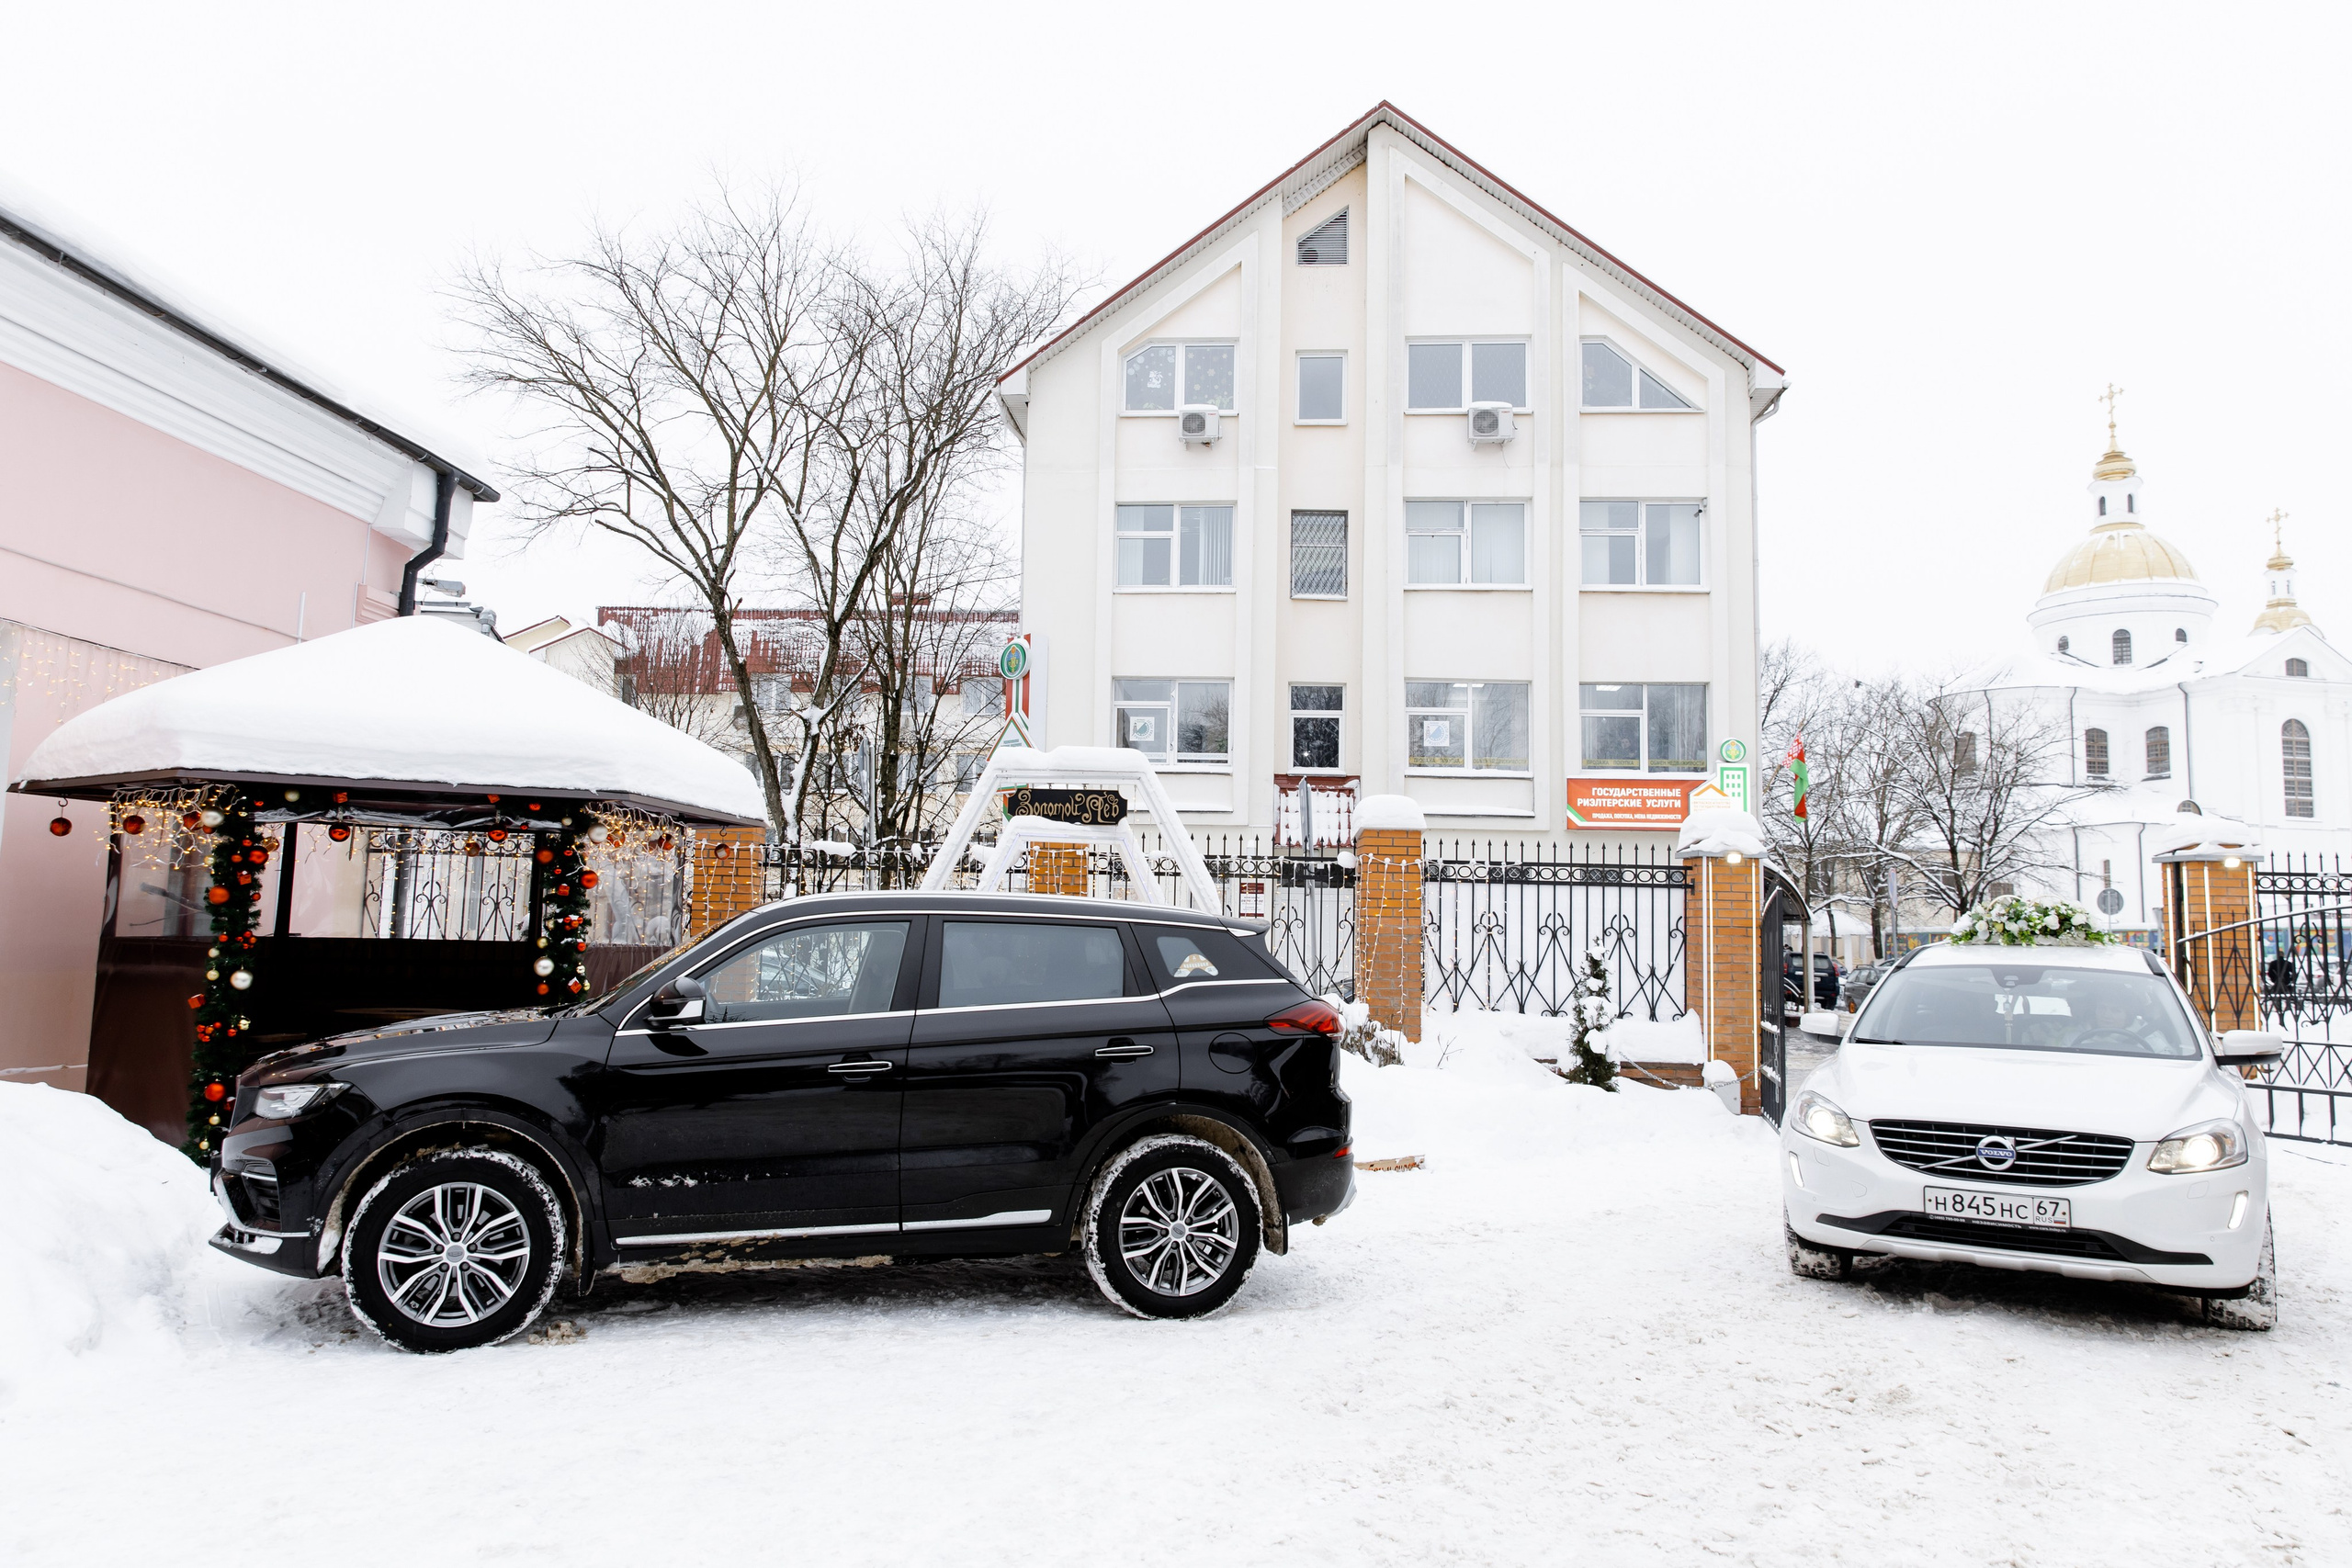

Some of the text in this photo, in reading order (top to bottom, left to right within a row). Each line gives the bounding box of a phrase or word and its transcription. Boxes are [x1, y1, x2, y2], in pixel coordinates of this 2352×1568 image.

[1591, 787, 1681, 797] ГОСУДАРСТВЕННЫЕ
[1577, 797, 1681, 808] РИЭЛТЕРСКИЕ УСЛУГИ
[1979, 1148, 2013, 1157] VOLVO
[2036, 1200, 2060, 1217] 67
[2035, 1215, 2053, 1224] RUS
